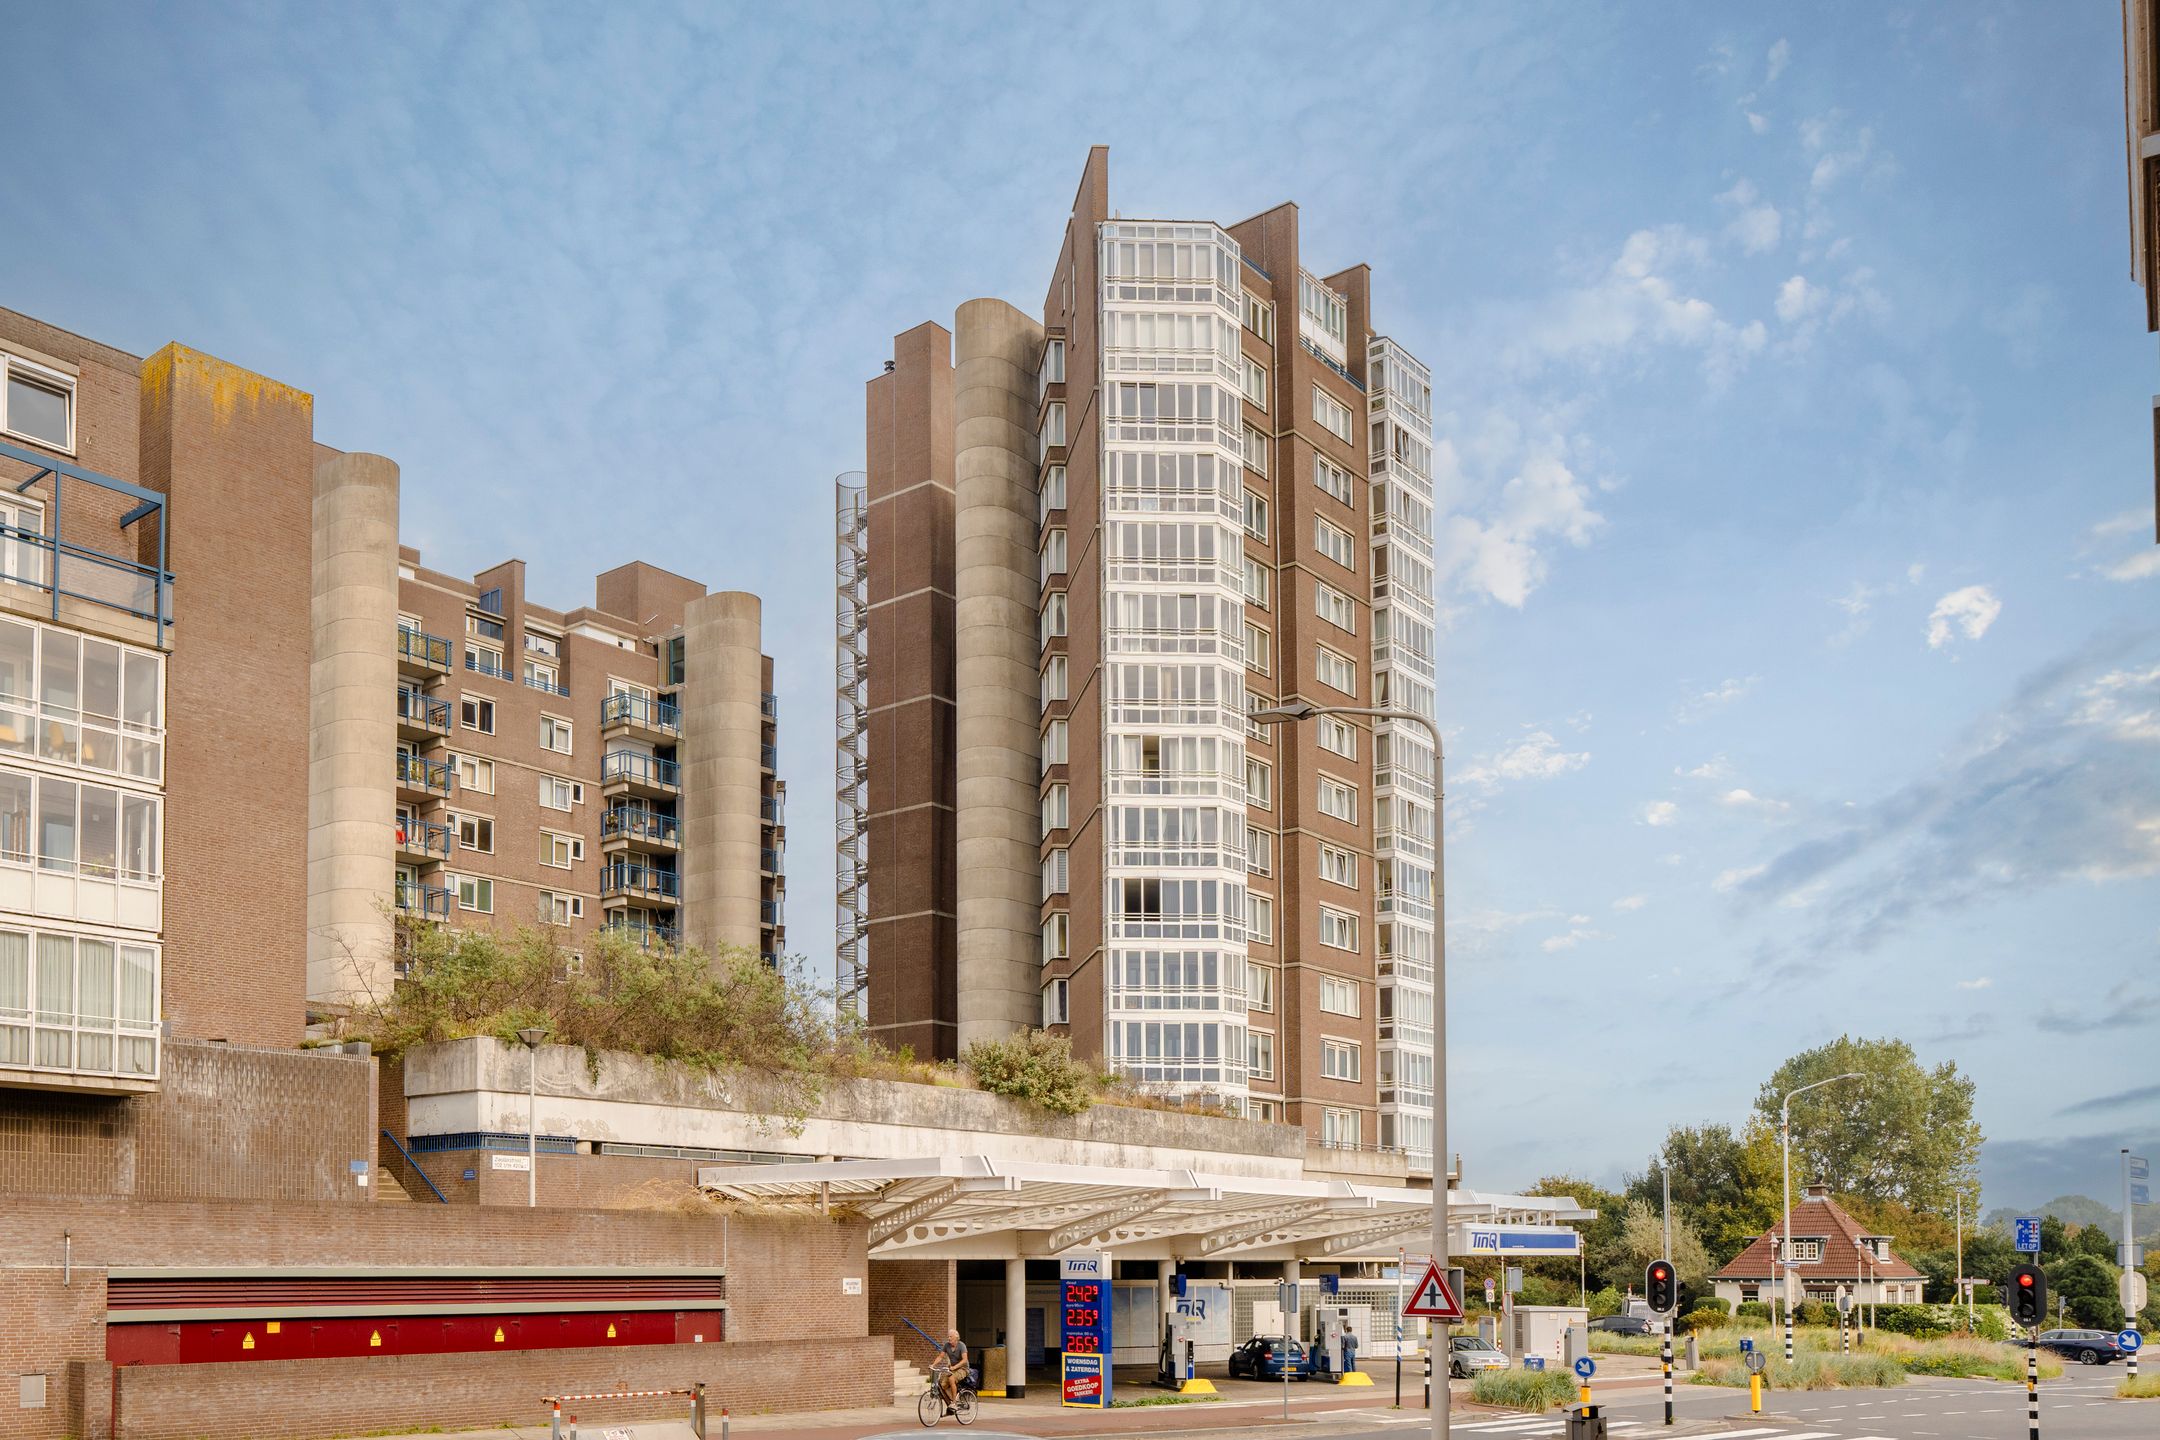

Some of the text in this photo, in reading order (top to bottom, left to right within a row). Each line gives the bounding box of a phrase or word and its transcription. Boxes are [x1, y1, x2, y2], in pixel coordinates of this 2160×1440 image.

[1471, 1232, 1497, 1252] TinQ
[1066, 1260, 1098, 1273] TinQ
[1066, 1382, 1099, 1392] GOEDKOOP
